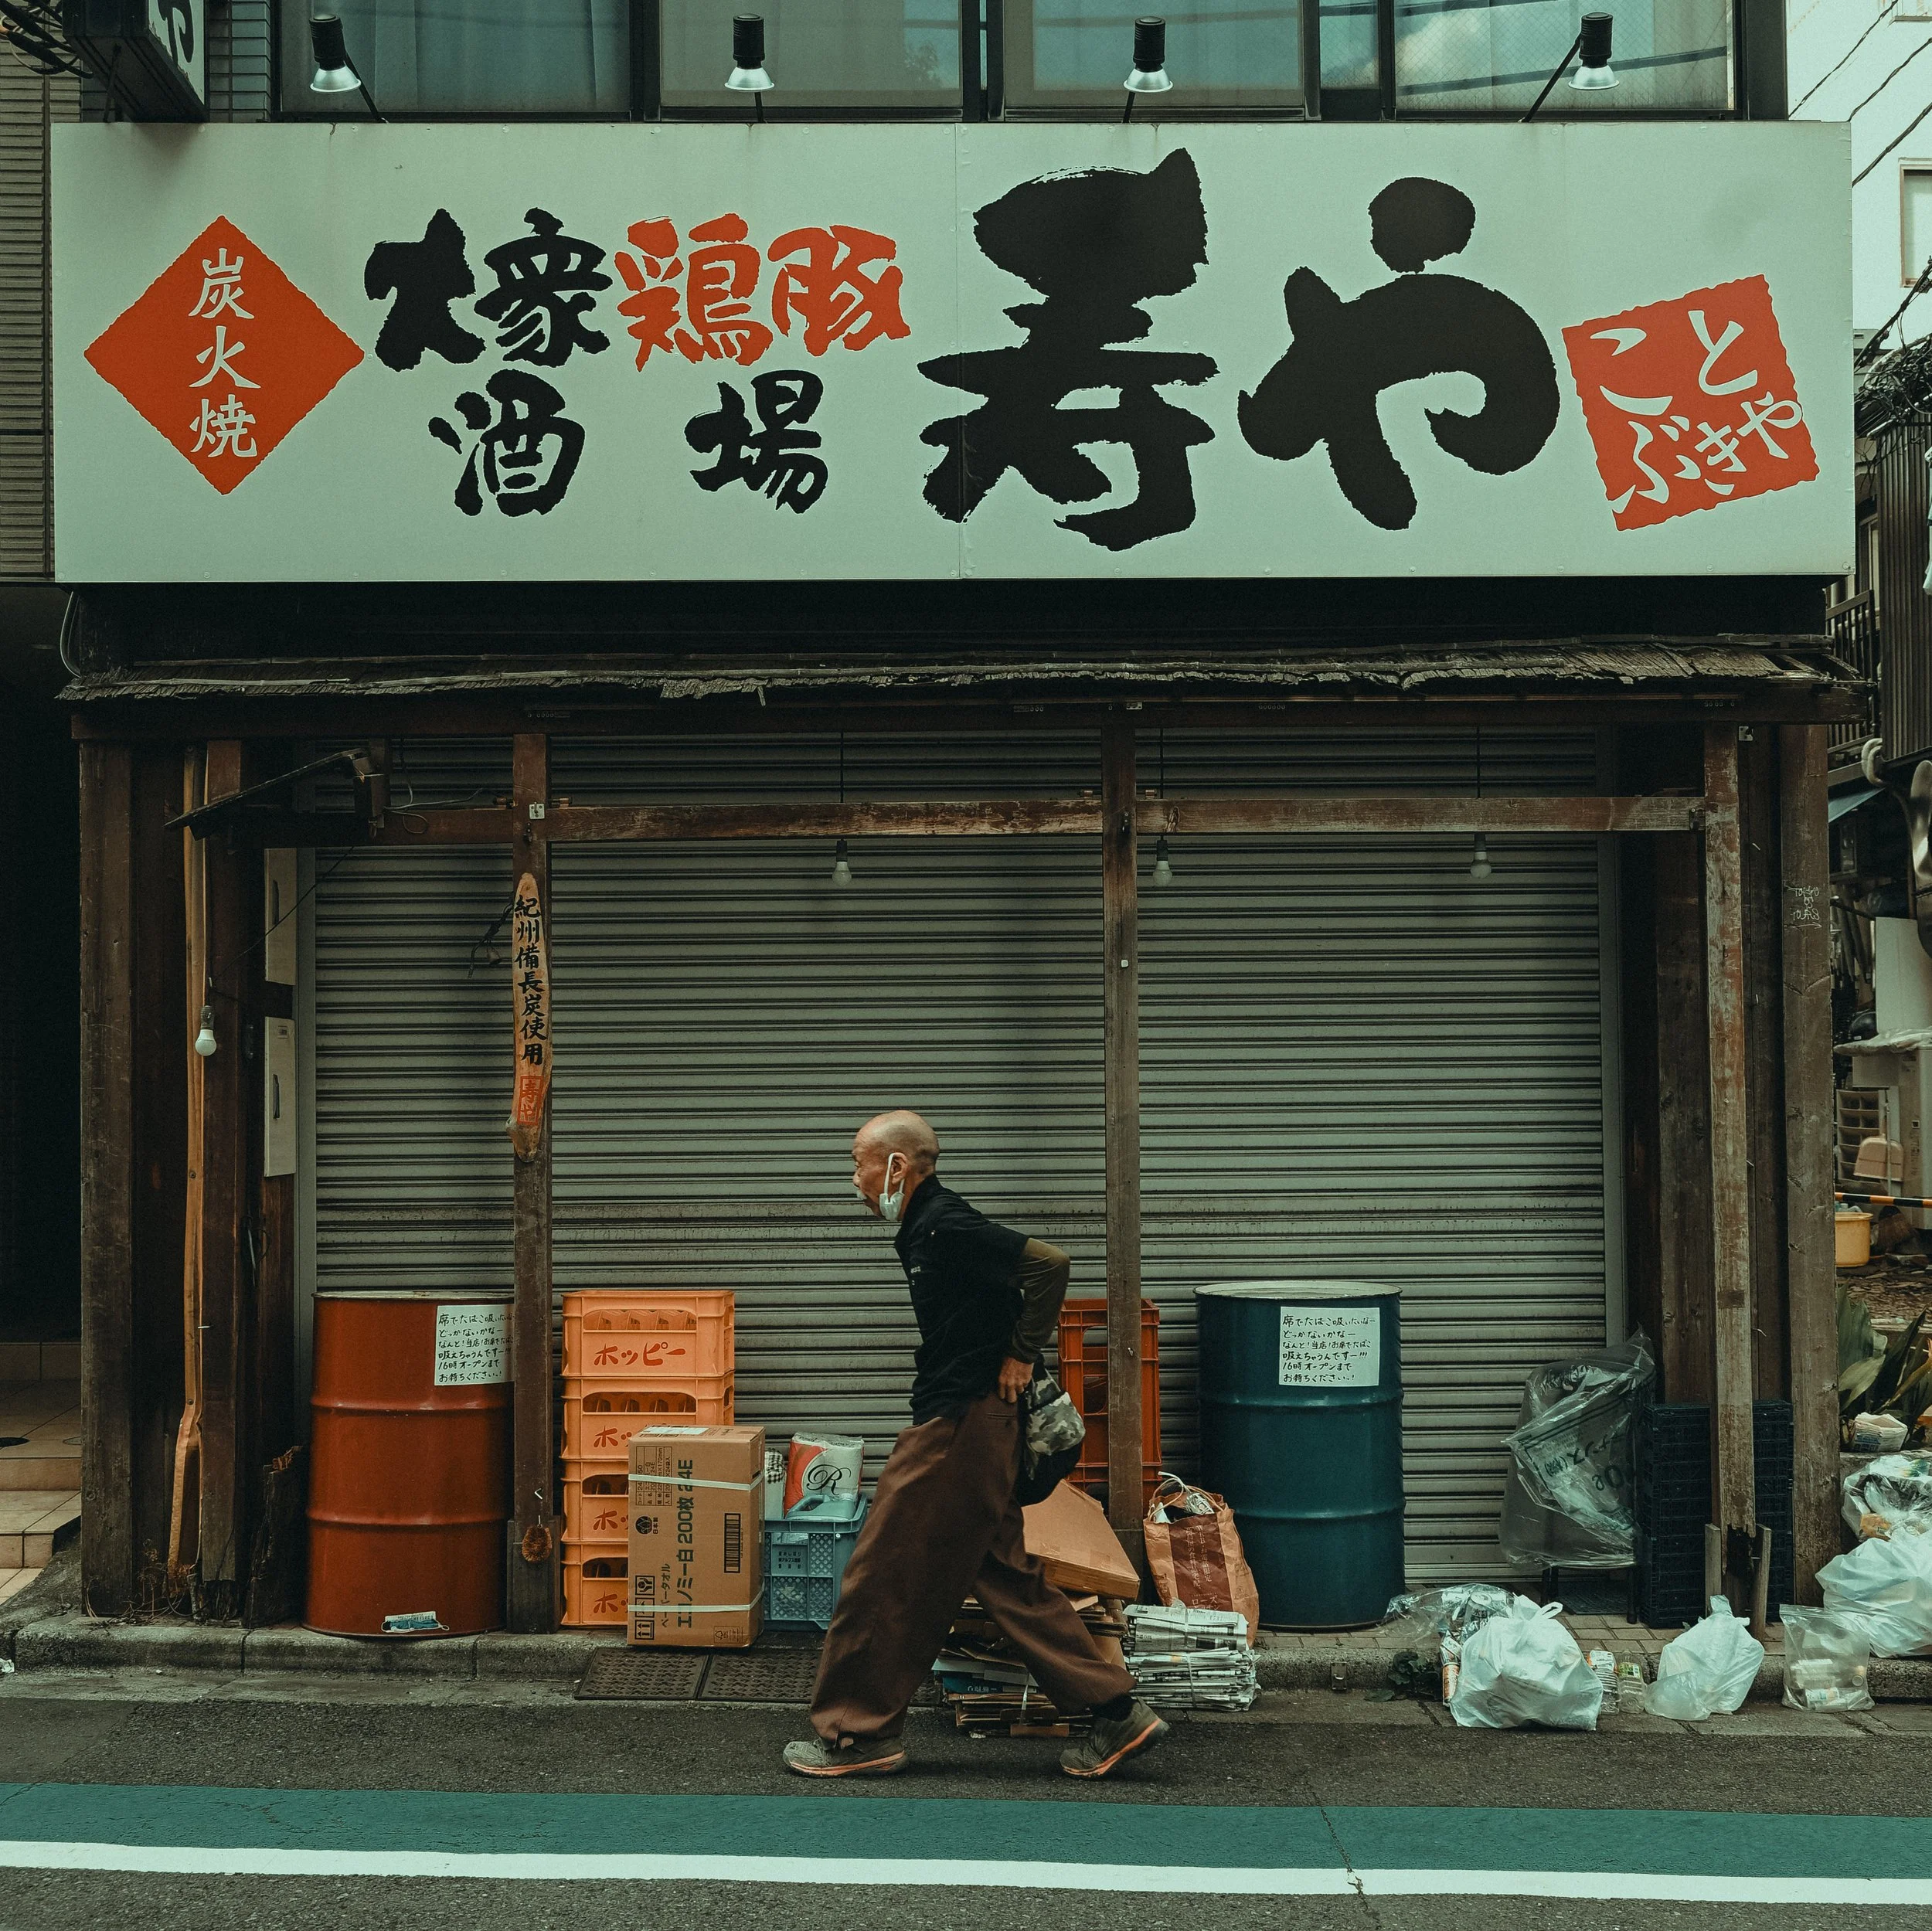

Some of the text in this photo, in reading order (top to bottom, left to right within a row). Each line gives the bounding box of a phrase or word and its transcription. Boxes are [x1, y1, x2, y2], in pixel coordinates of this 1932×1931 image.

[188, 247, 261, 458] 炭火焼
[514, 894, 548, 1066] 紀州備長炭使用
[594, 1341, 686, 1366] ホッピー
